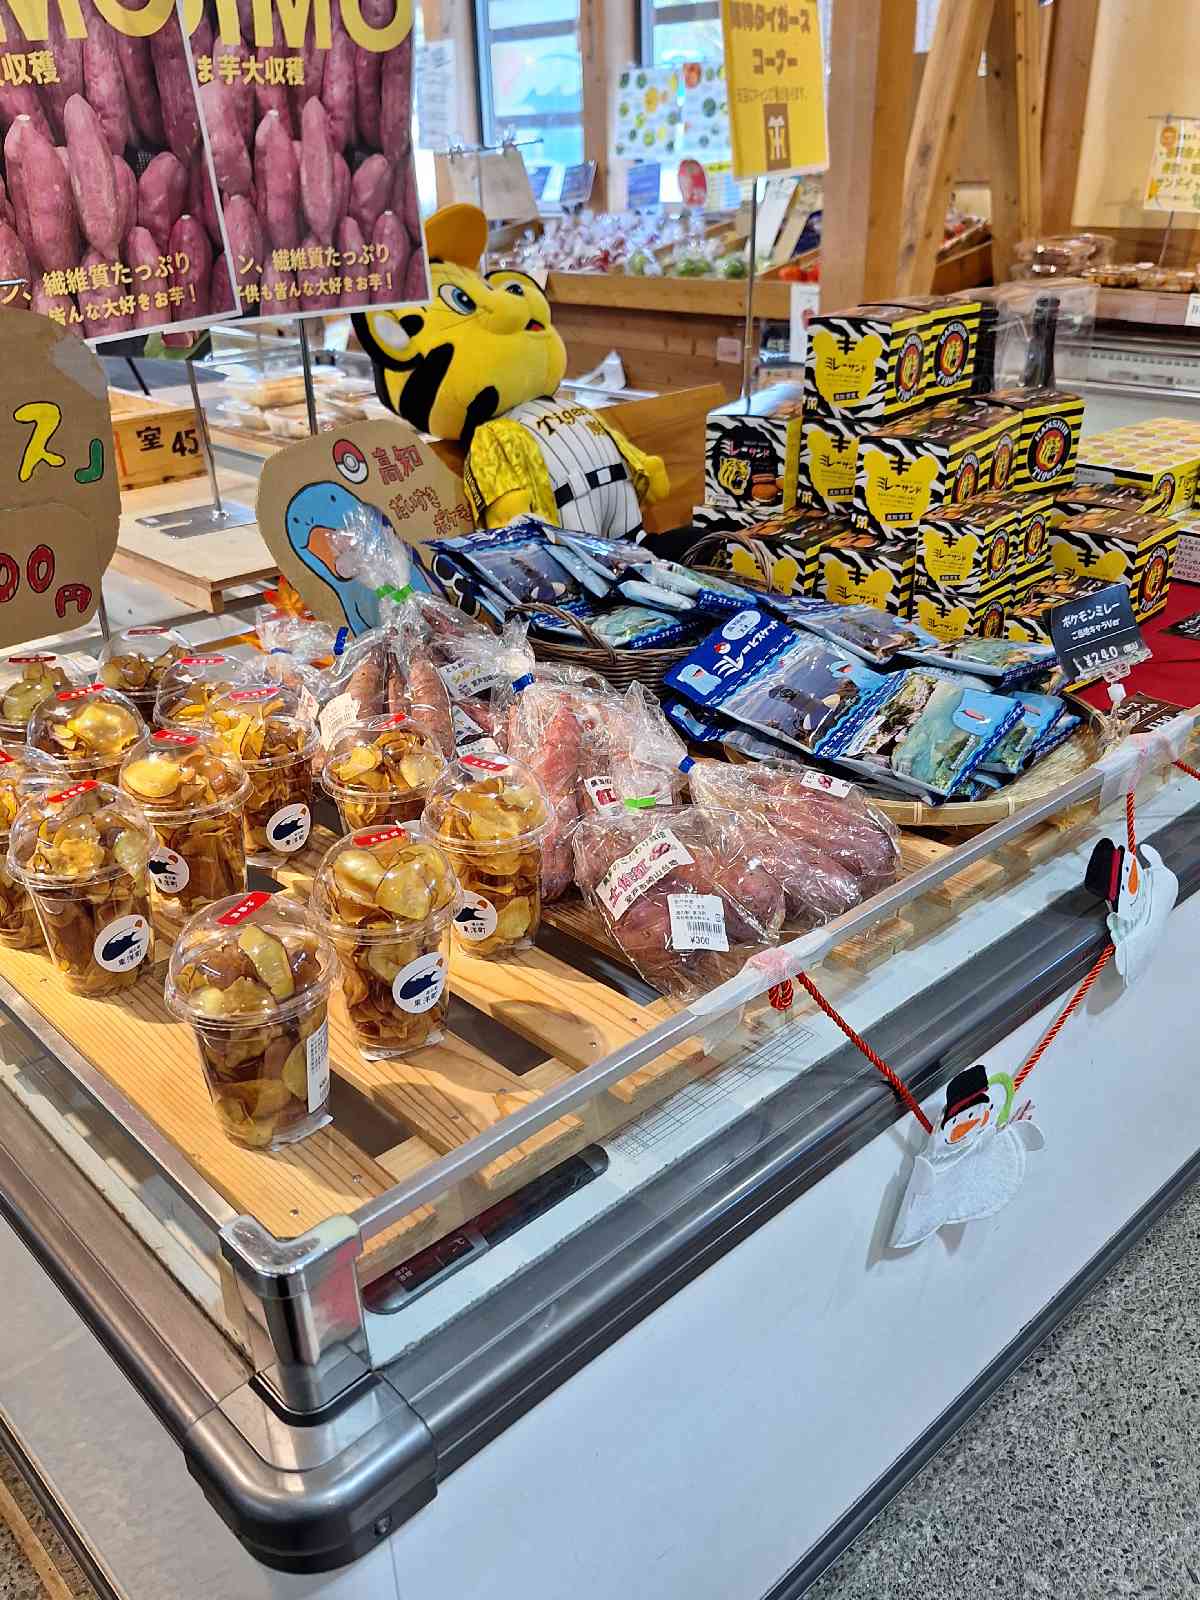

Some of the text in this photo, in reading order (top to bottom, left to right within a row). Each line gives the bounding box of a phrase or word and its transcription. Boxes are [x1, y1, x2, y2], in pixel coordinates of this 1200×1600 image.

[0, 50, 60, 86] 収穫
[752, 48, 798, 76] コーナー
[136, 426, 199, 457] 室 45
[370, 445, 424, 486] 高知
[1062, 602, 1121, 628] ポケモンミレー
[1083, 645, 1119, 667] ¥240
[690, 935, 711, 946] ¥300
